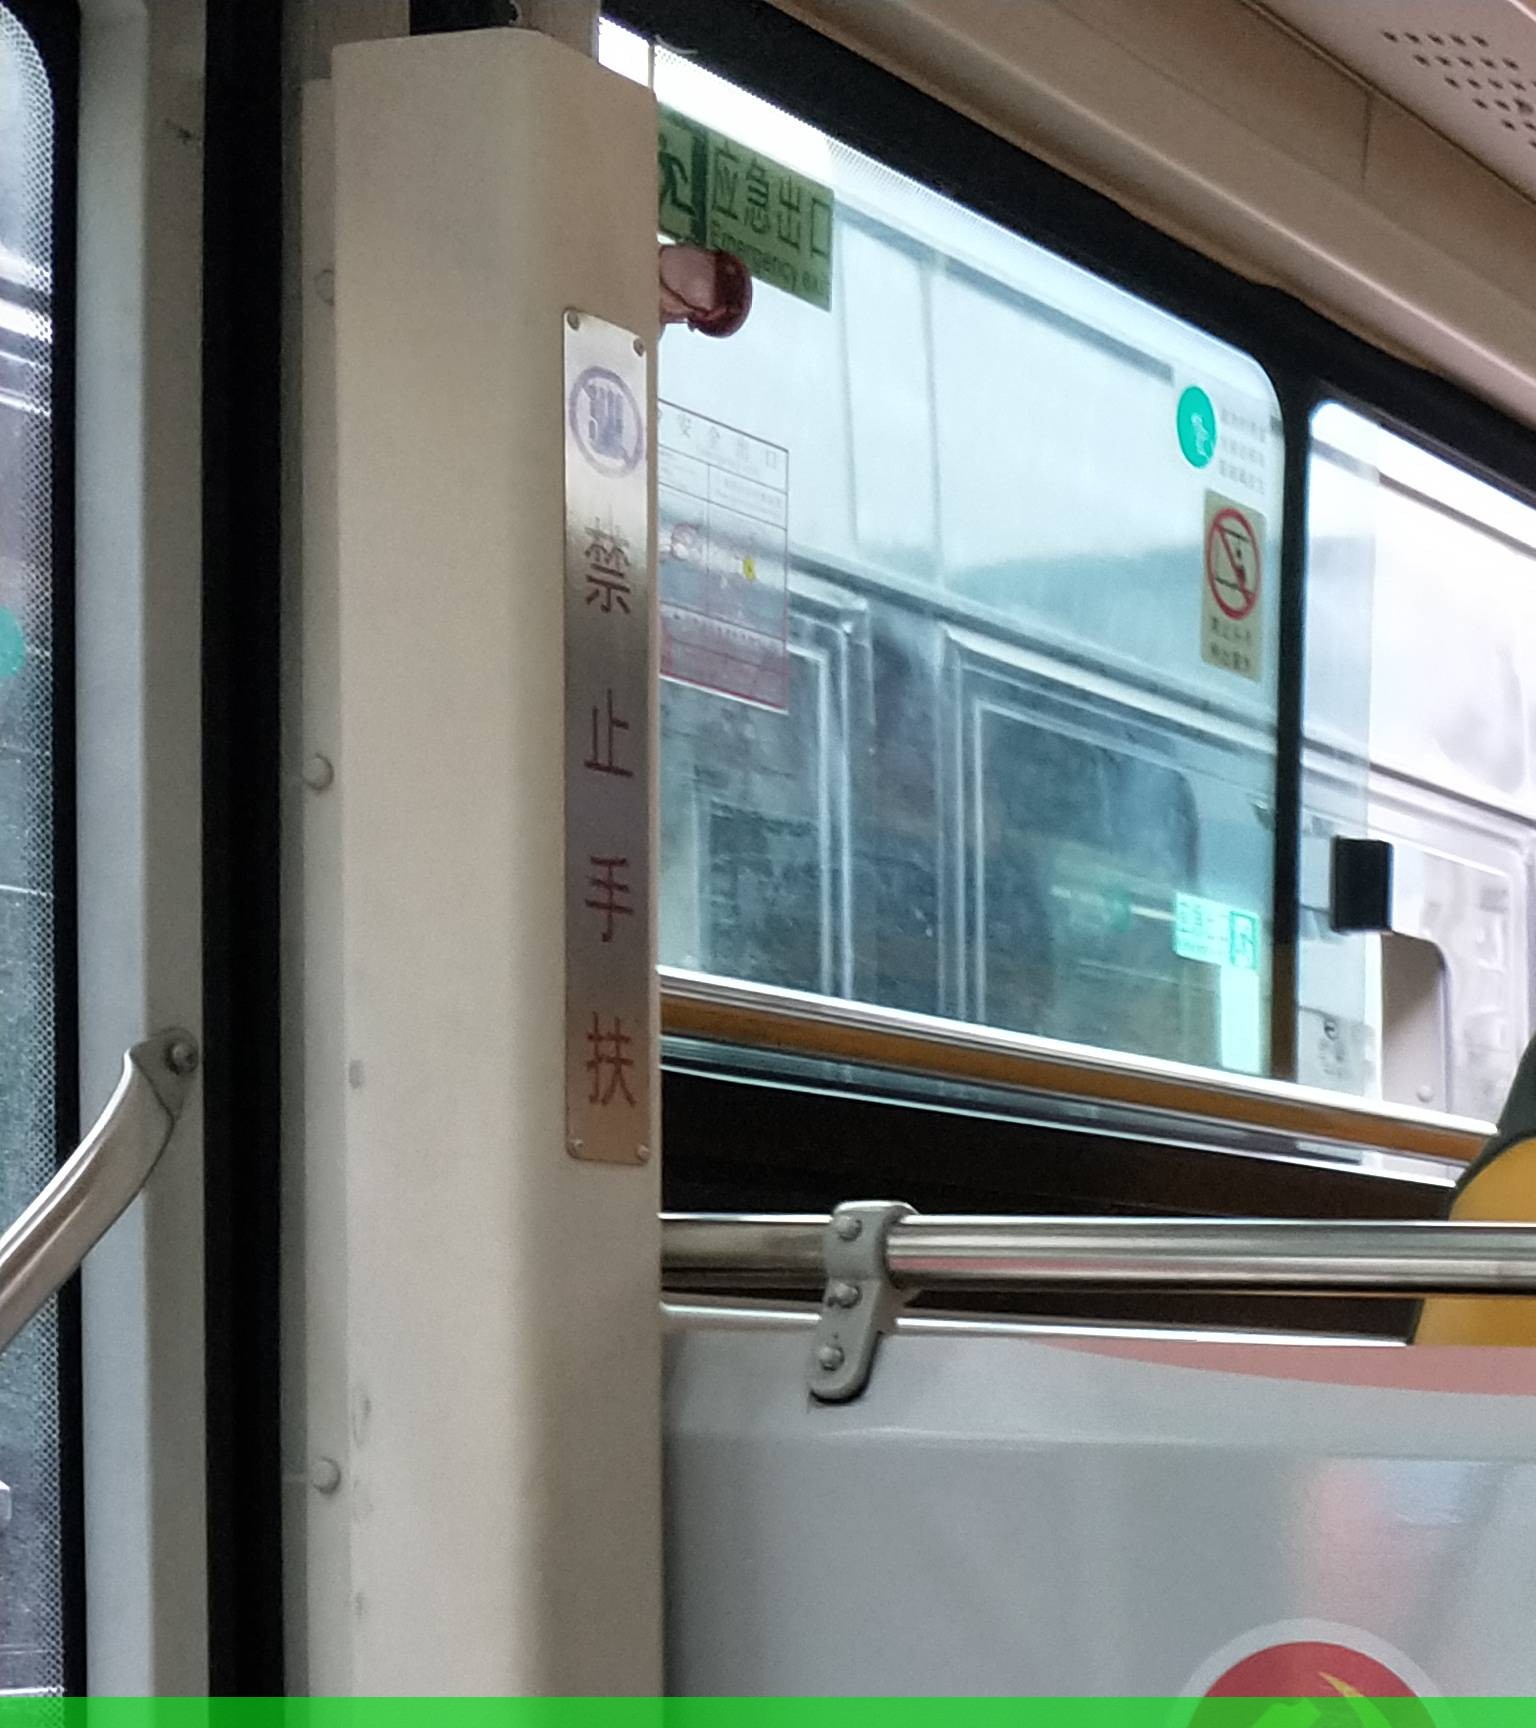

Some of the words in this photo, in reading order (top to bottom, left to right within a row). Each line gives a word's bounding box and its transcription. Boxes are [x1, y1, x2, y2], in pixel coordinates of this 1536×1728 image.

[711, 139, 832, 259] 应急出口
[584, 515, 635, 1108] 禁止手扶
